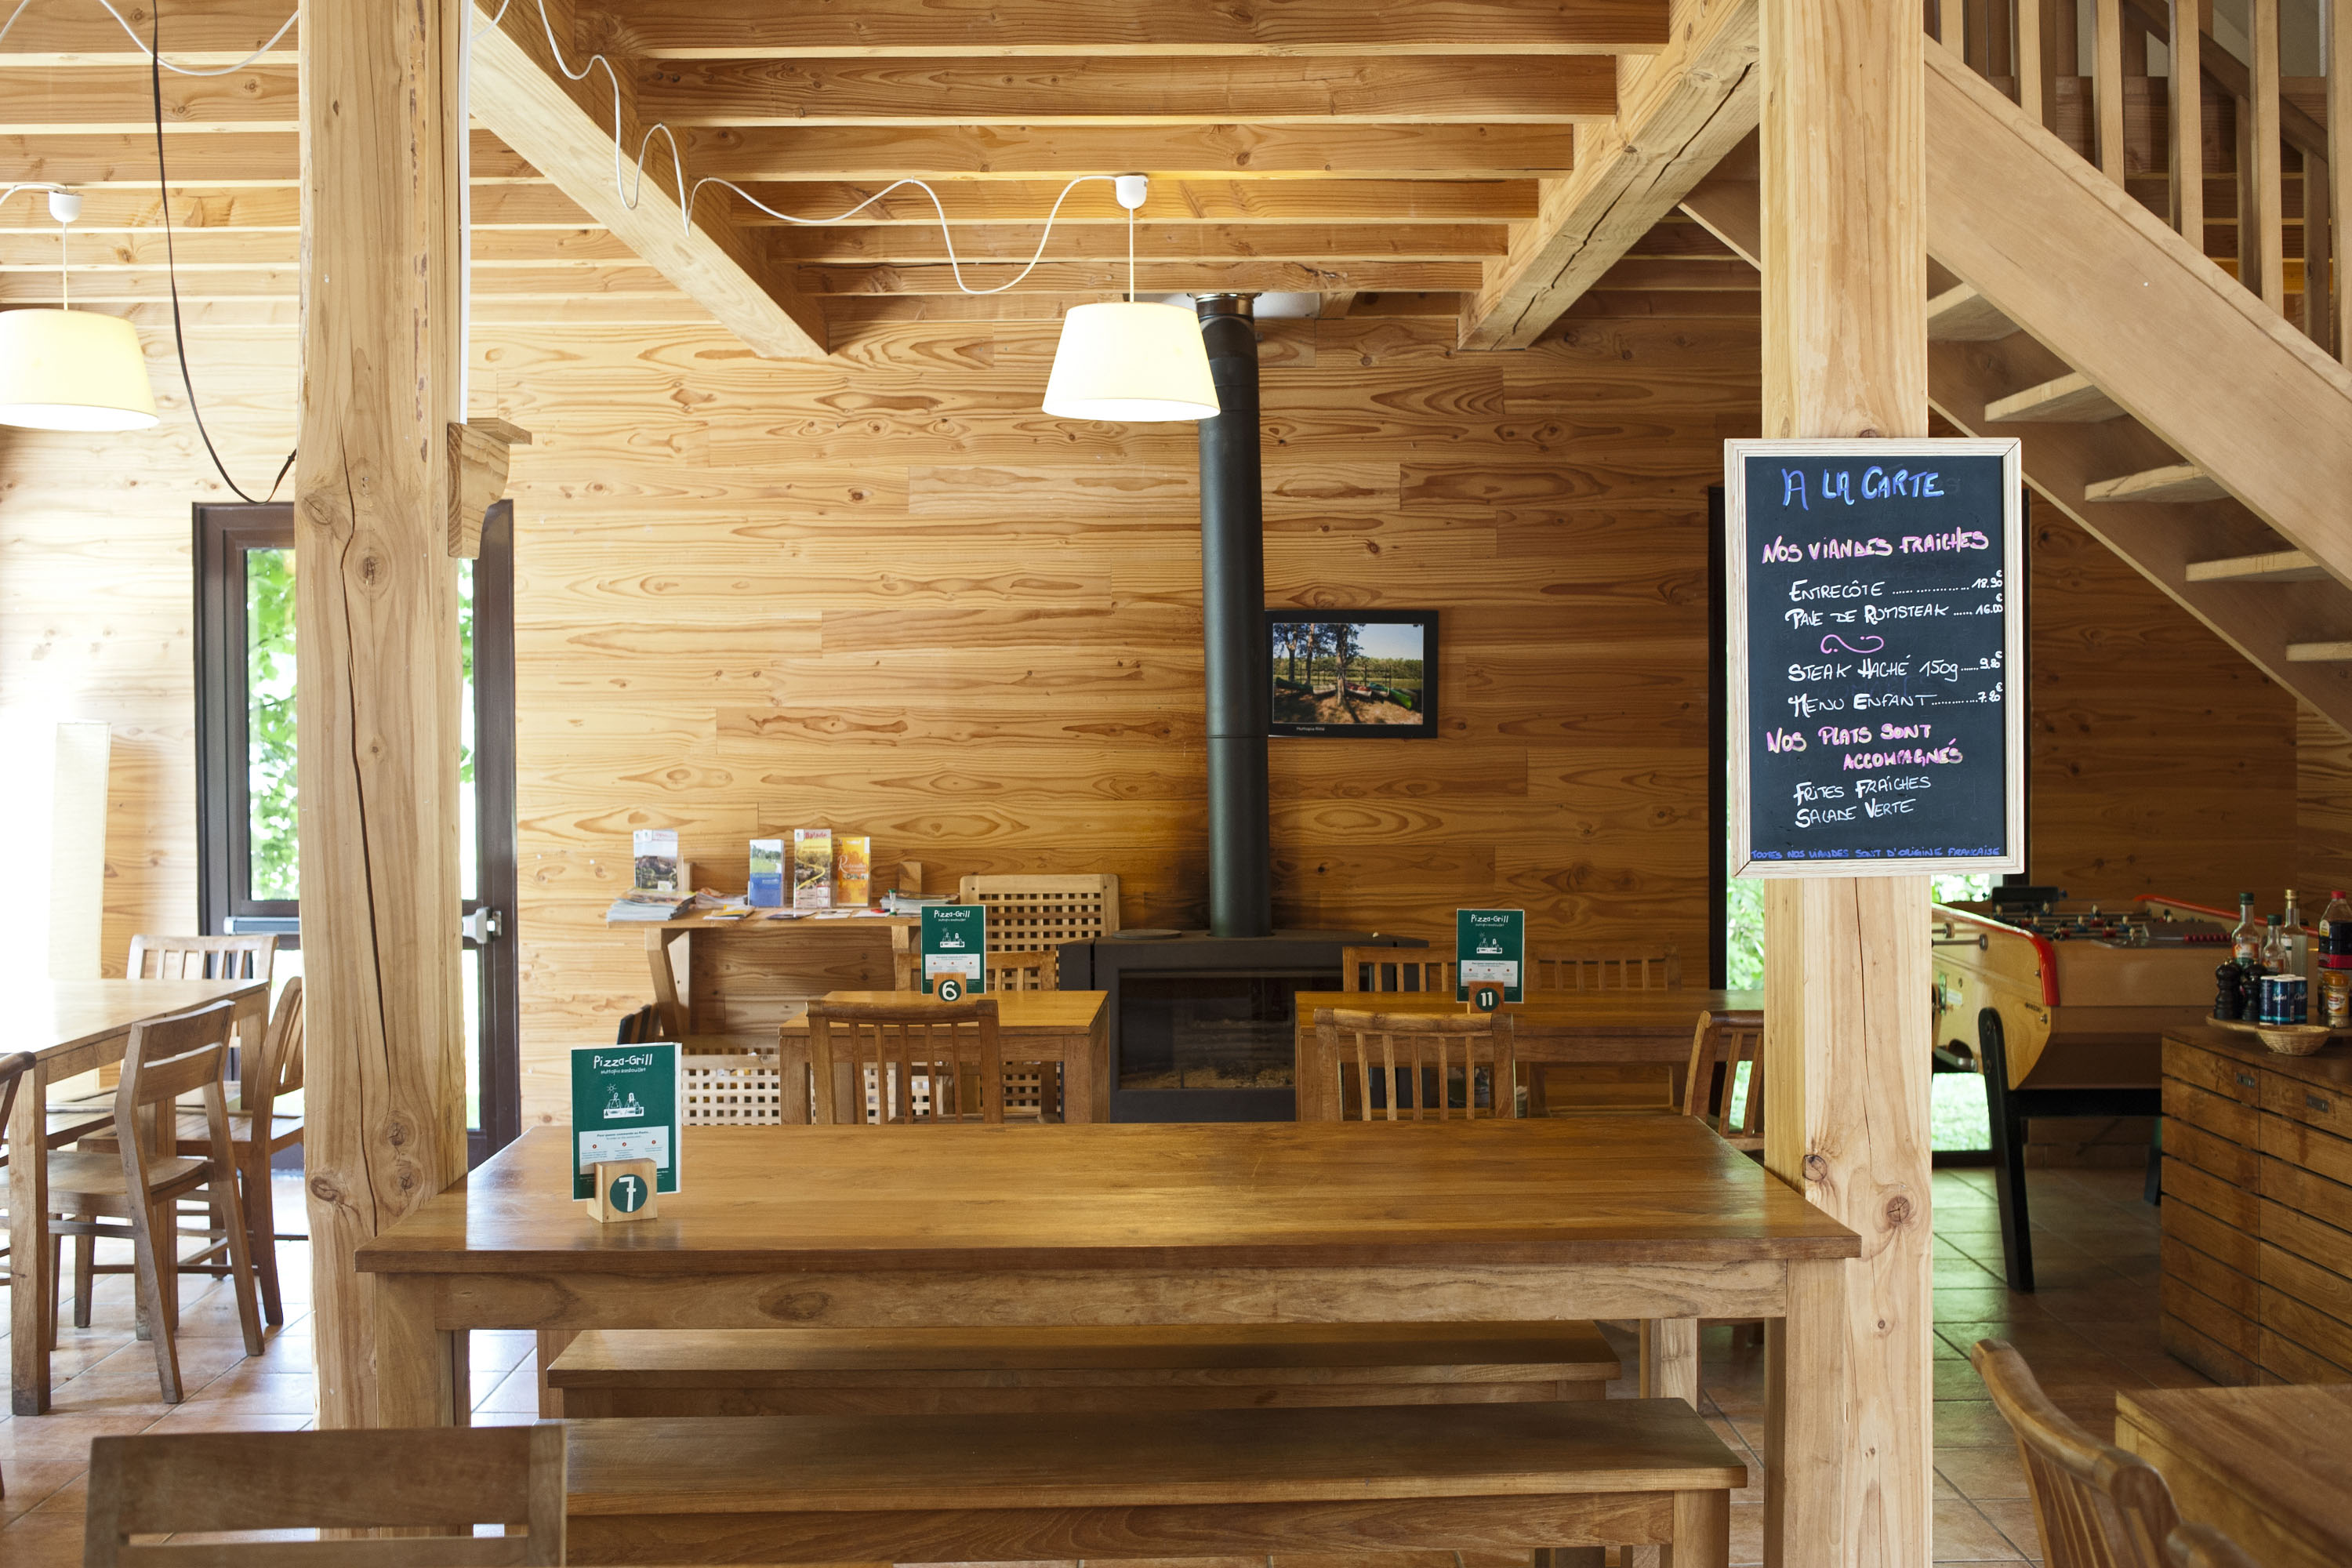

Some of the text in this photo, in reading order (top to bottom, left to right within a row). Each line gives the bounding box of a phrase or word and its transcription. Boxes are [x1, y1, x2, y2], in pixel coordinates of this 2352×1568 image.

[1780, 465, 1945, 511] A LA CARTE
[1762, 535, 1803, 564] NOS
[1807, 536, 1893, 561] VIANDES
[1788, 579, 1886, 602] ENTRECÔTE
[1829, 611, 1858, 623] DE
[1788, 662, 1853, 682] STEAK
[1857, 654, 1911, 680] HACHÉ
[1918, 659, 1958, 683] 150g
[1788, 692, 1845, 718] MENU
[1853, 692, 1938, 710] ENFANT
[1766, 723, 1932, 753] NOS PLATS SONT
[1842, 738, 1963, 771] ACCOMPAGNÉS
[1792, 781, 1845, 807] FRITES
[1795, 797, 1917, 829] SALADE VERTE
[1787, 850, 1806, 858] NOS
[1854, 848, 1882, 858] SONT
[934, 909, 971, 918] Pizza-Grill
[1471, 913, 1509, 923] Pizza-Grill
[942, 980, 957, 1001] 6
[1480, 992, 1493, 1007] 11
[593, 1053, 653, 1069] Pizza-Grill
[619, 1176, 637, 1212] 7
